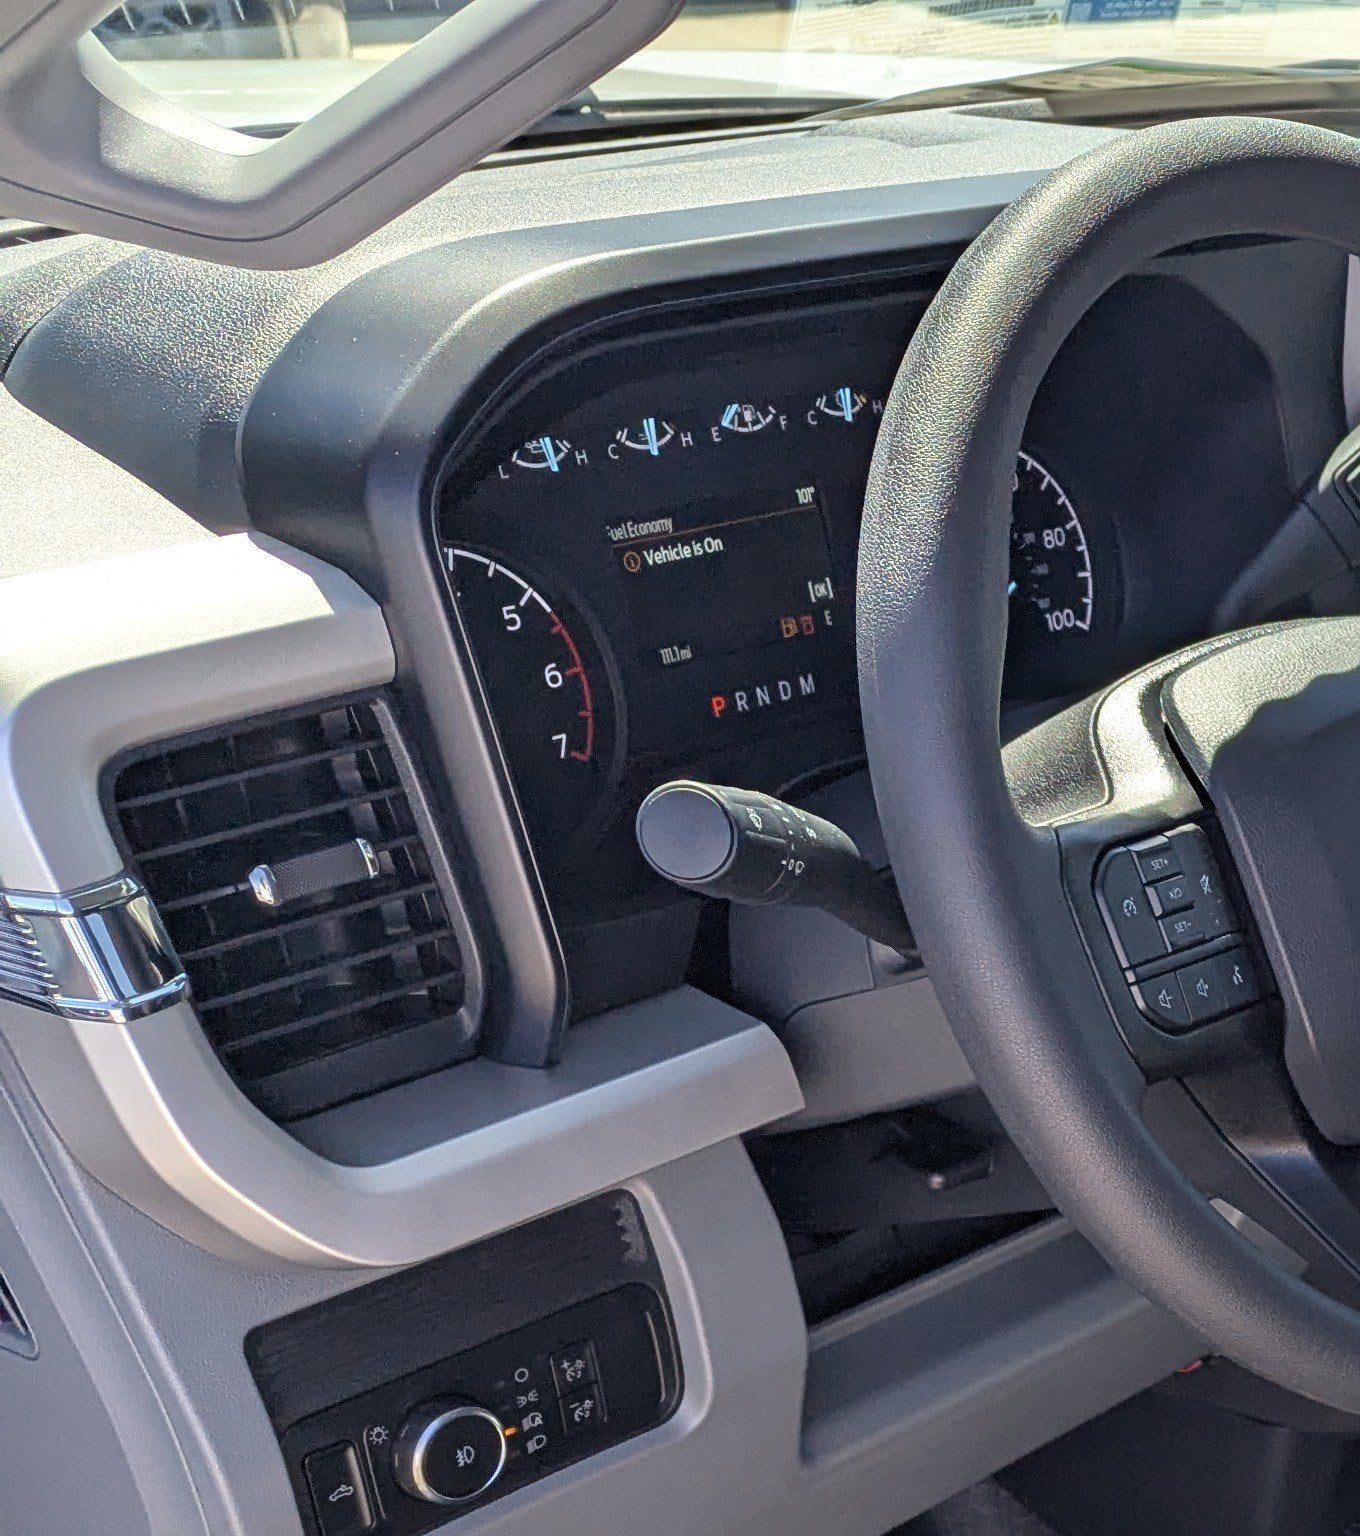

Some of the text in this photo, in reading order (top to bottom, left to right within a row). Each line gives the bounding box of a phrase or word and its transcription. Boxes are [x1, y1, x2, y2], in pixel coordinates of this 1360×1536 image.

[711, 415, 788, 442] E F
[807, 410, 818, 426] C
[575, 451, 588, 466] H
[608, 432, 693, 459] C H
[628, 517, 673, 539] Economy
[1042, 526, 1066, 549] 80
[643, 537, 724, 566] Vehicle is On
[502, 605, 521, 631] 5
[1045, 608, 1075, 632] 100
[544, 662, 563, 688] 6
[710, 674, 816, 717] P R N D M
[552, 733, 567, 759] 7
